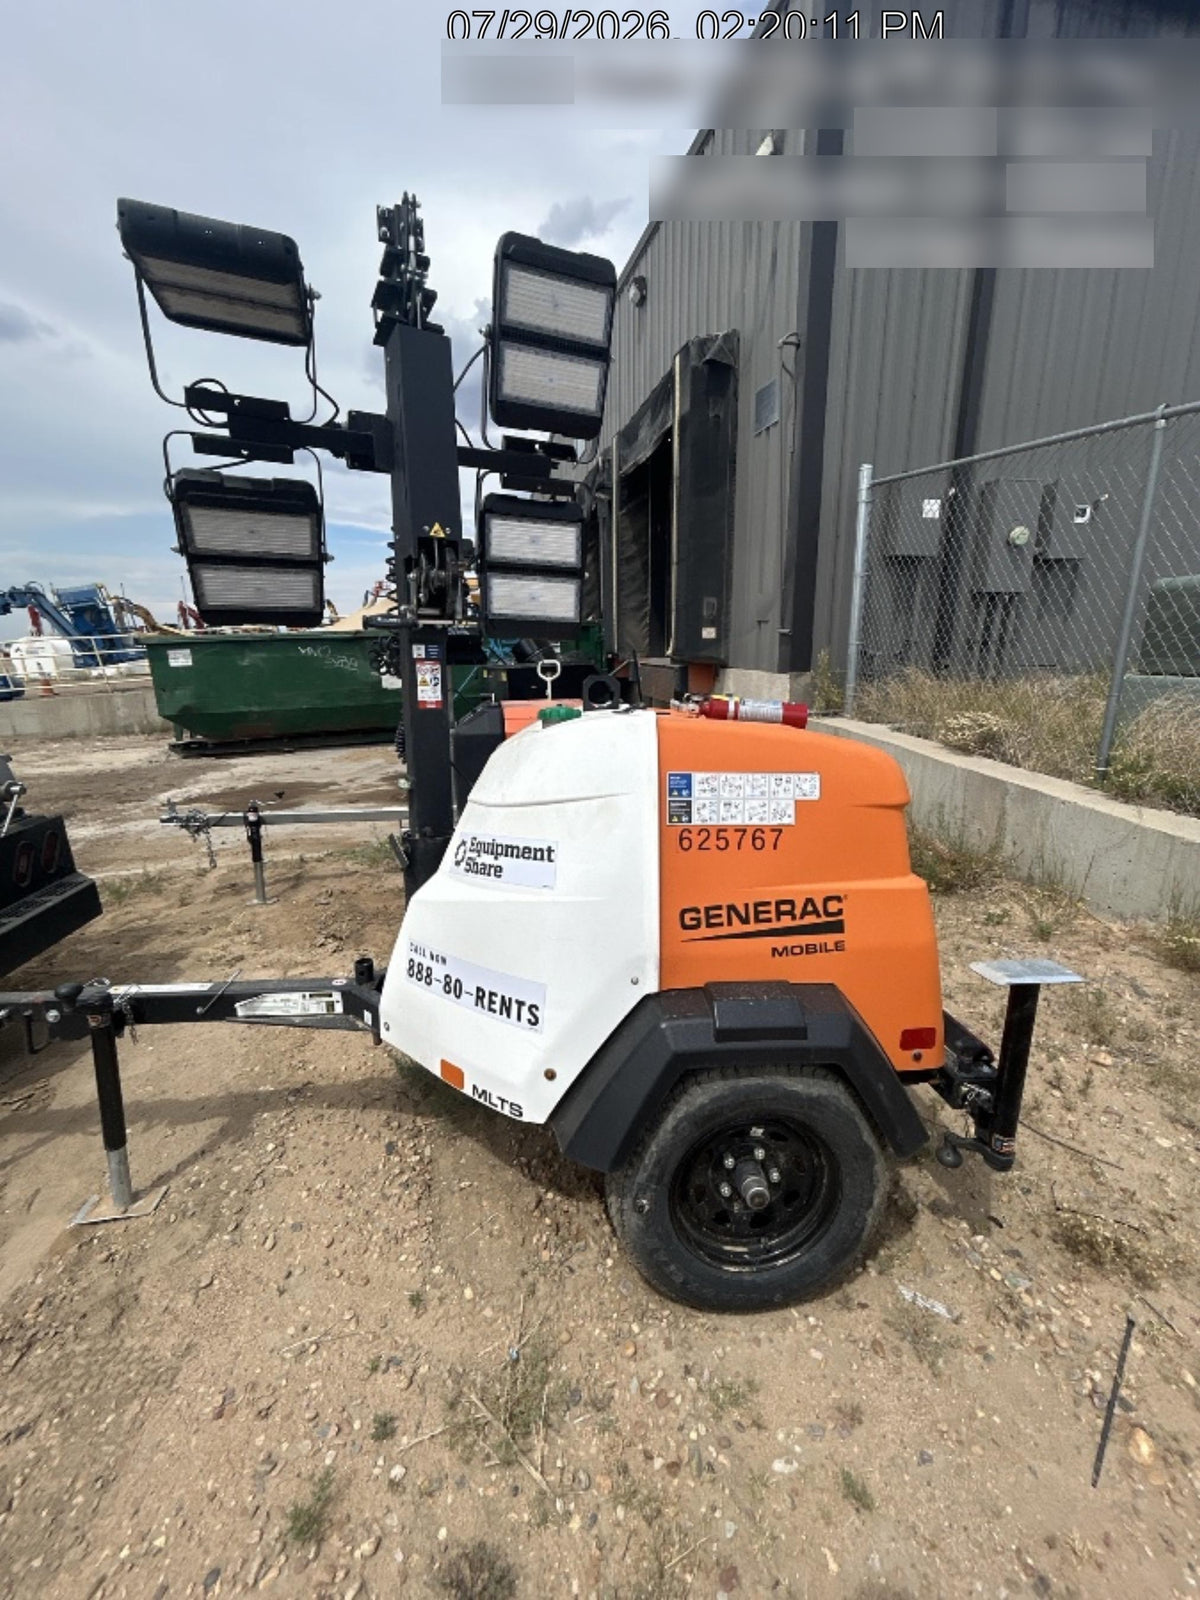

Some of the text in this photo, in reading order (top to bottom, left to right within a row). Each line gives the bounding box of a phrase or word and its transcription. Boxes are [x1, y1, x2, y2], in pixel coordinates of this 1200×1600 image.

[469, 837, 555, 862] Equipment
[679, 828, 783, 851] 625767
[464, 856, 503, 878] Share
[679, 895, 843, 931] GENERAC
[771, 940, 846, 958] MOBILE
[407, 958, 540, 1026] 888-80-RENTS
[472, 1084, 523, 1118] MLTS
